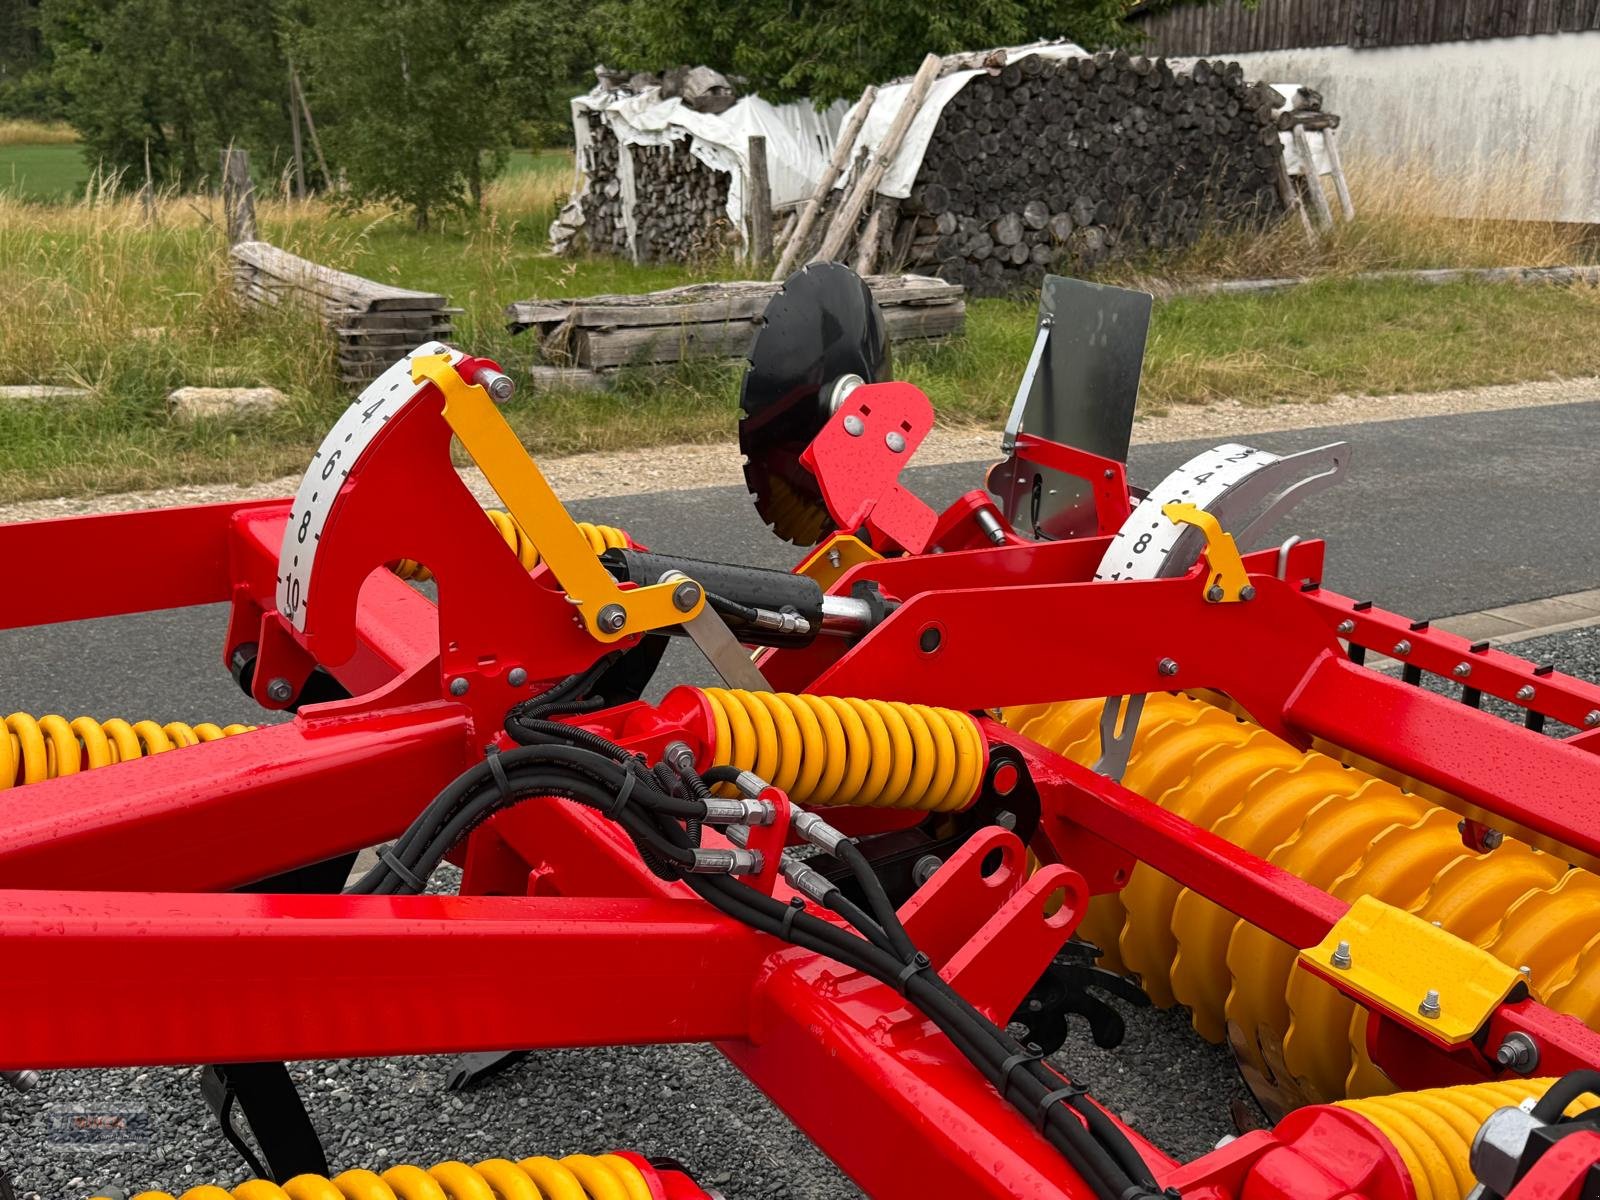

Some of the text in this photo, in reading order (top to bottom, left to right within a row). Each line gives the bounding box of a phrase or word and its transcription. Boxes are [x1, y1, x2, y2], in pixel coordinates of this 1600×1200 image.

[361, 398, 386, 424] 4
[321, 450, 342, 481] 6
[1223, 452, 1249, 464] 2
[1192, 471, 1215, 486] 4
[297, 510, 312, 544] 8
[1132, 532, 1153, 554] 8
[286, 572, 300, 613] 10
